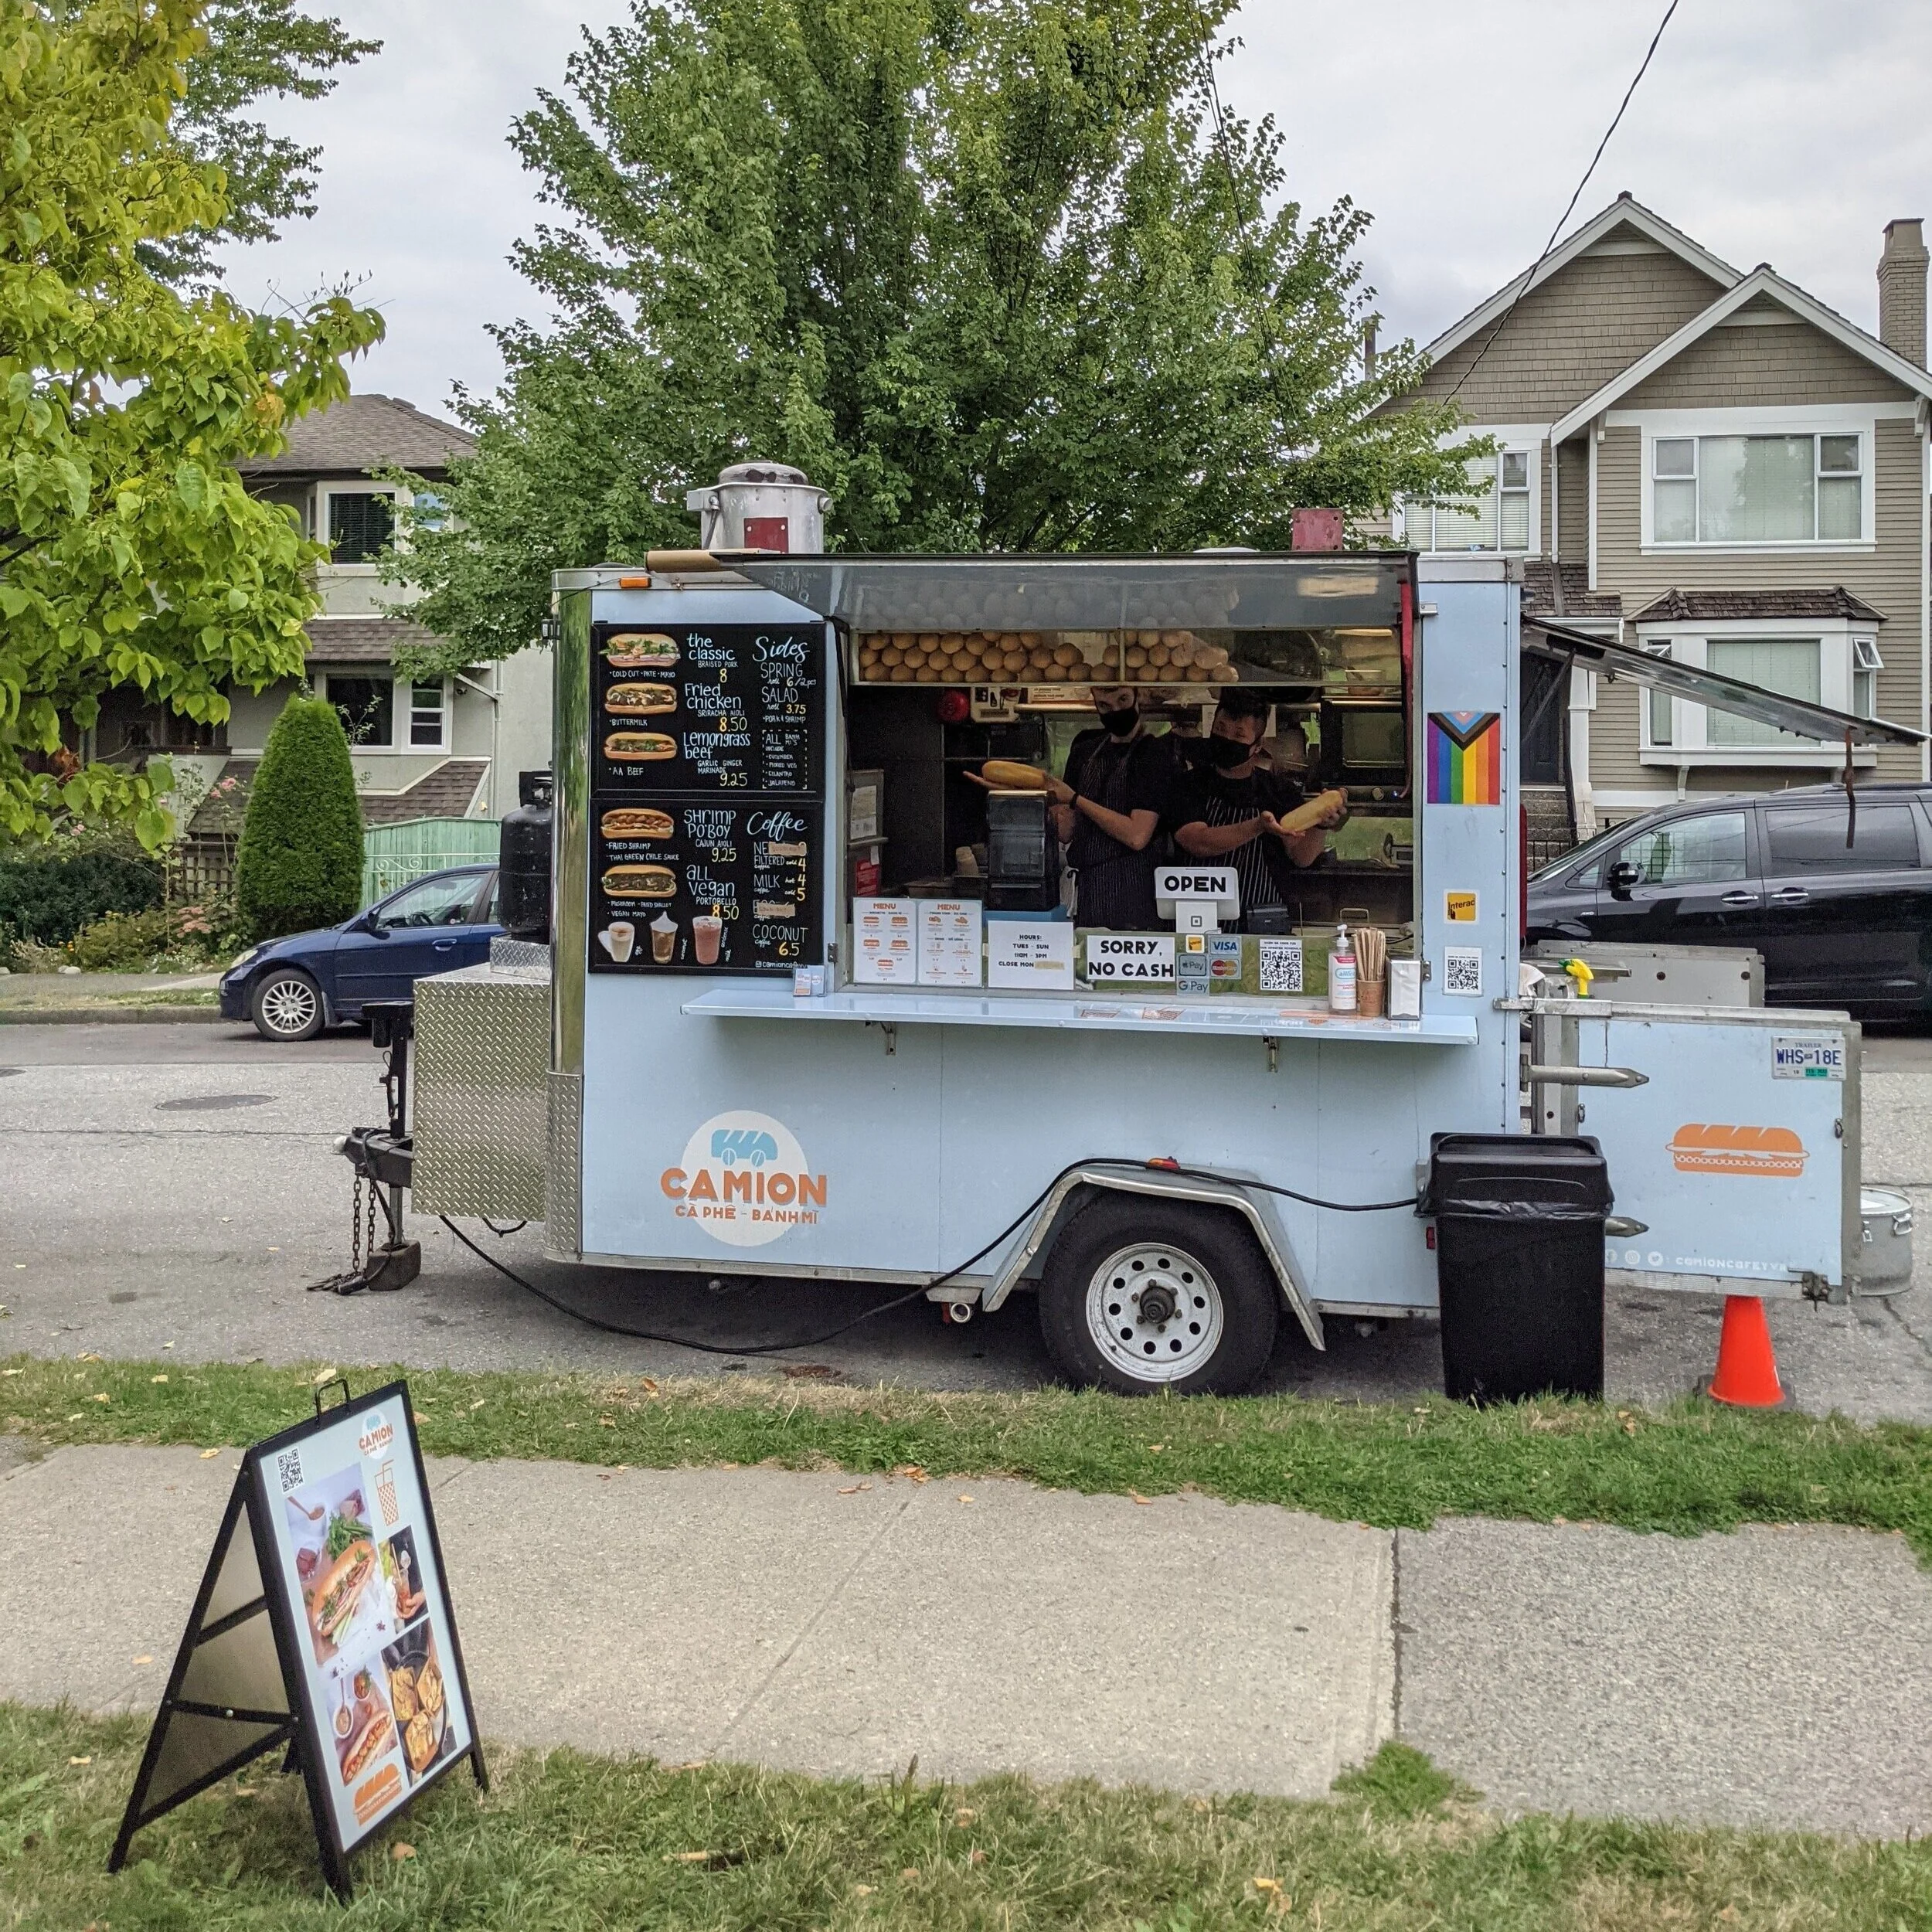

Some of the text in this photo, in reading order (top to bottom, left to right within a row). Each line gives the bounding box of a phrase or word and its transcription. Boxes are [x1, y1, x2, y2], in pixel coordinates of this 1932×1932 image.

[686, 633, 713, 648] the
[689, 646, 736, 661] classic
[752, 636, 811, 663] Sides
[697, 660, 722, 668] BRAISED
[760, 662, 804, 679] SPRING
[719, 668, 727, 683] 8
[685, 683, 720, 696] Fried
[761, 685, 798, 703] SALAD
[686, 696, 742, 709] chicken
[786, 704, 806, 714] 3.75
[611, 718, 648, 726] BUTTERMILK
[719, 716, 747, 732] 8.50
[683, 732, 751, 747] Lemongrass
[685, 746, 713, 760] beef
[613, 767, 644, 776] AA BEEF
[719, 773, 748, 787] 9.25
[747, 811, 808, 842] Coffee
[608, 842, 651, 850] FRIED SHRIMP
[696, 838, 733, 848] CAJUN AIOLI
[712, 847, 736, 862] 9.25
[754, 855, 785, 866] FILTERED
[798, 858, 807, 872] 4
[753, 874, 781, 888] MILK
[798, 873, 807, 886] 4
[1164, 875, 1226, 893] OPEN
[689, 881, 735, 896] vegan
[797, 887, 806, 901] 5
[696, 896, 736, 906] PORTOBELLO
[712, 904, 740, 920] 8.50
[753, 923, 809, 943] COCONUT
[778, 941, 800, 956] 6.5
[1100, 940, 1162, 957] SORRY,
[1213, 941, 1237, 951] VISA
[1088, 961, 1174, 978] NO CASH
[1189, 961, 1204, 971] Pay
[1179, 980, 1208, 993] G Pay
[661, 1168, 827, 1208] CAMION
[359, 1423, 393, 1450] CAMION
